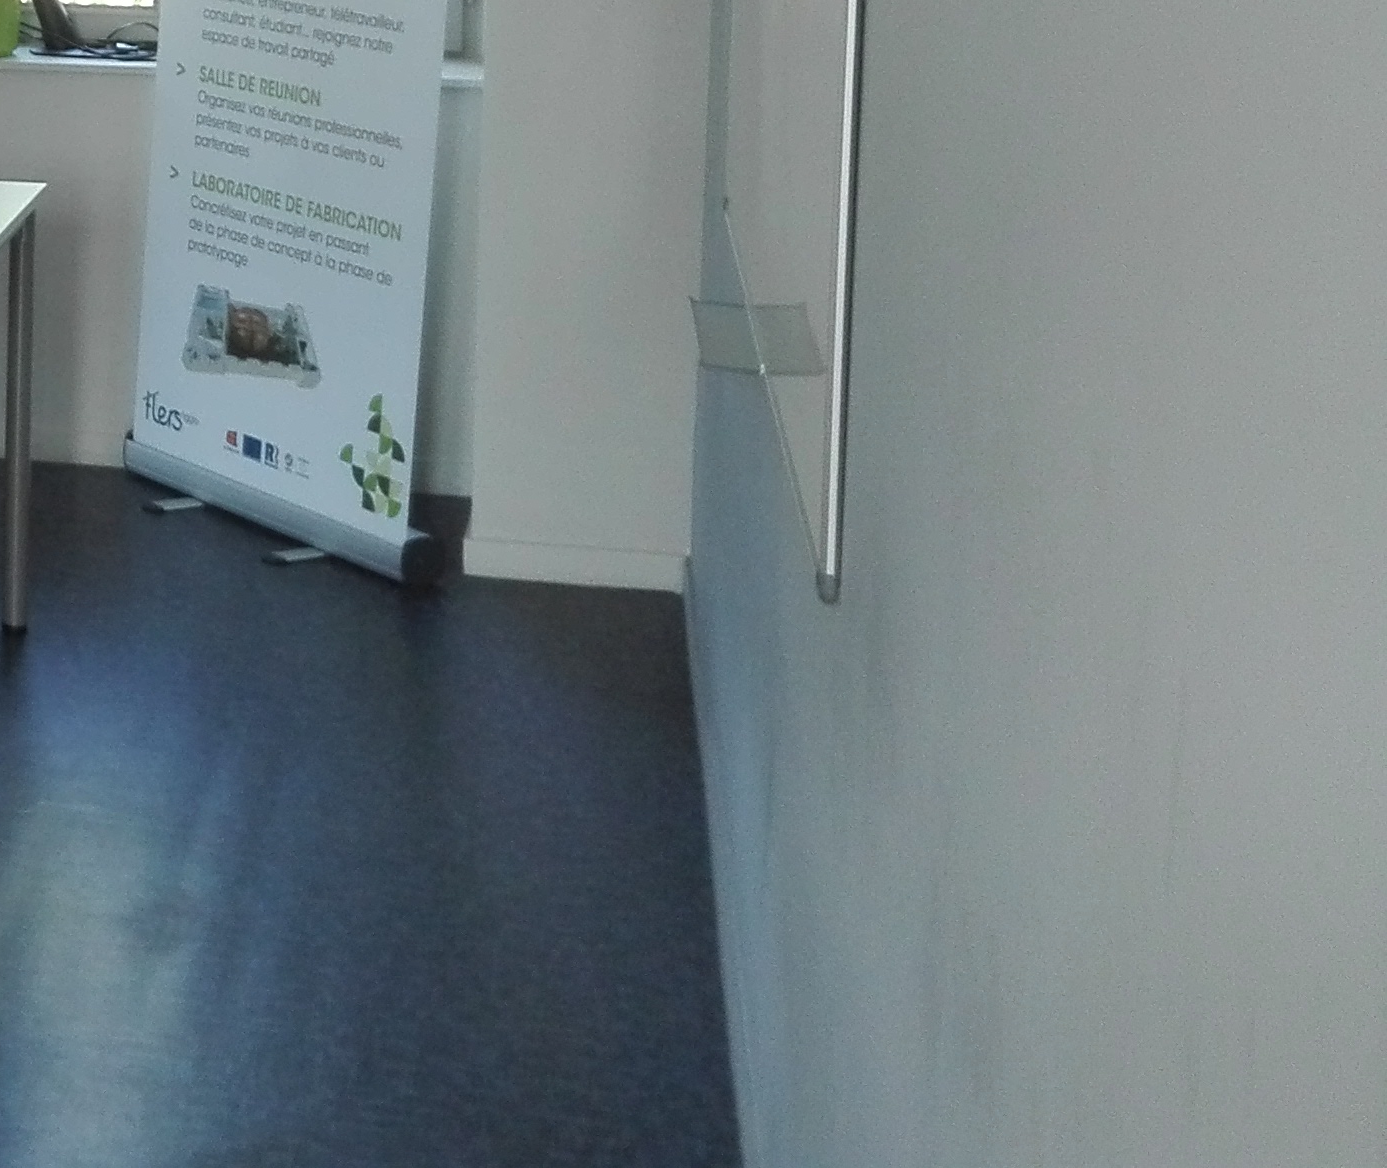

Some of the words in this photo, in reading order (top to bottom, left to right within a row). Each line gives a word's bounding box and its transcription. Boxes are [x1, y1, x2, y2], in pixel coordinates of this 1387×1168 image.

[201, 29, 239, 47] espace
[241, 33, 256, 50] de
[258, 37, 290, 58] travail
[291, 45, 336, 68] partagé
[312, 28, 362, 50] rejoignez
[364, 36, 394, 55] notre
[199, 65, 235, 89] SALLE
[238, 72, 255, 94] DE
[259, 76, 322, 107] REUNION
[197, 89, 247, 115] Organisez
[249, 100, 266, 118] vos
[268, 105, 312, 129] réunions
[193, 134, 251, 158] partenaires
[245, 123, 262, 139] vos
[263, 127, 298, 149] projets
[312, 135, 330, 155] vos
[332, 137, 367, 164] clients
[369, 153, 386, 168] ou
[190, 194, 247, 224] Concrétisez
[249, 212, 274, 231] votre
[276, 218, 307, 241] projet
[309, 227, 324, 244] en
[325, 232, 371, 257] passant
[191, 170, 282, 211] LABORATOIRE
[285, 193, 303, 215] DE
[306, 200, 404, 242] FABRICATION
[187, 237, 250, 268] prototypage
[188, 216, 204, 232] de
[205, 220, 216, 236] la
[216, 224, 248, 246] phase
[250, 231, 266, 250] de
[267, 239, 313, 264] concept
[325, 252, 337, 270] la
[338, 257, 374, 282] phase
[376, 268, 394, 287] de
